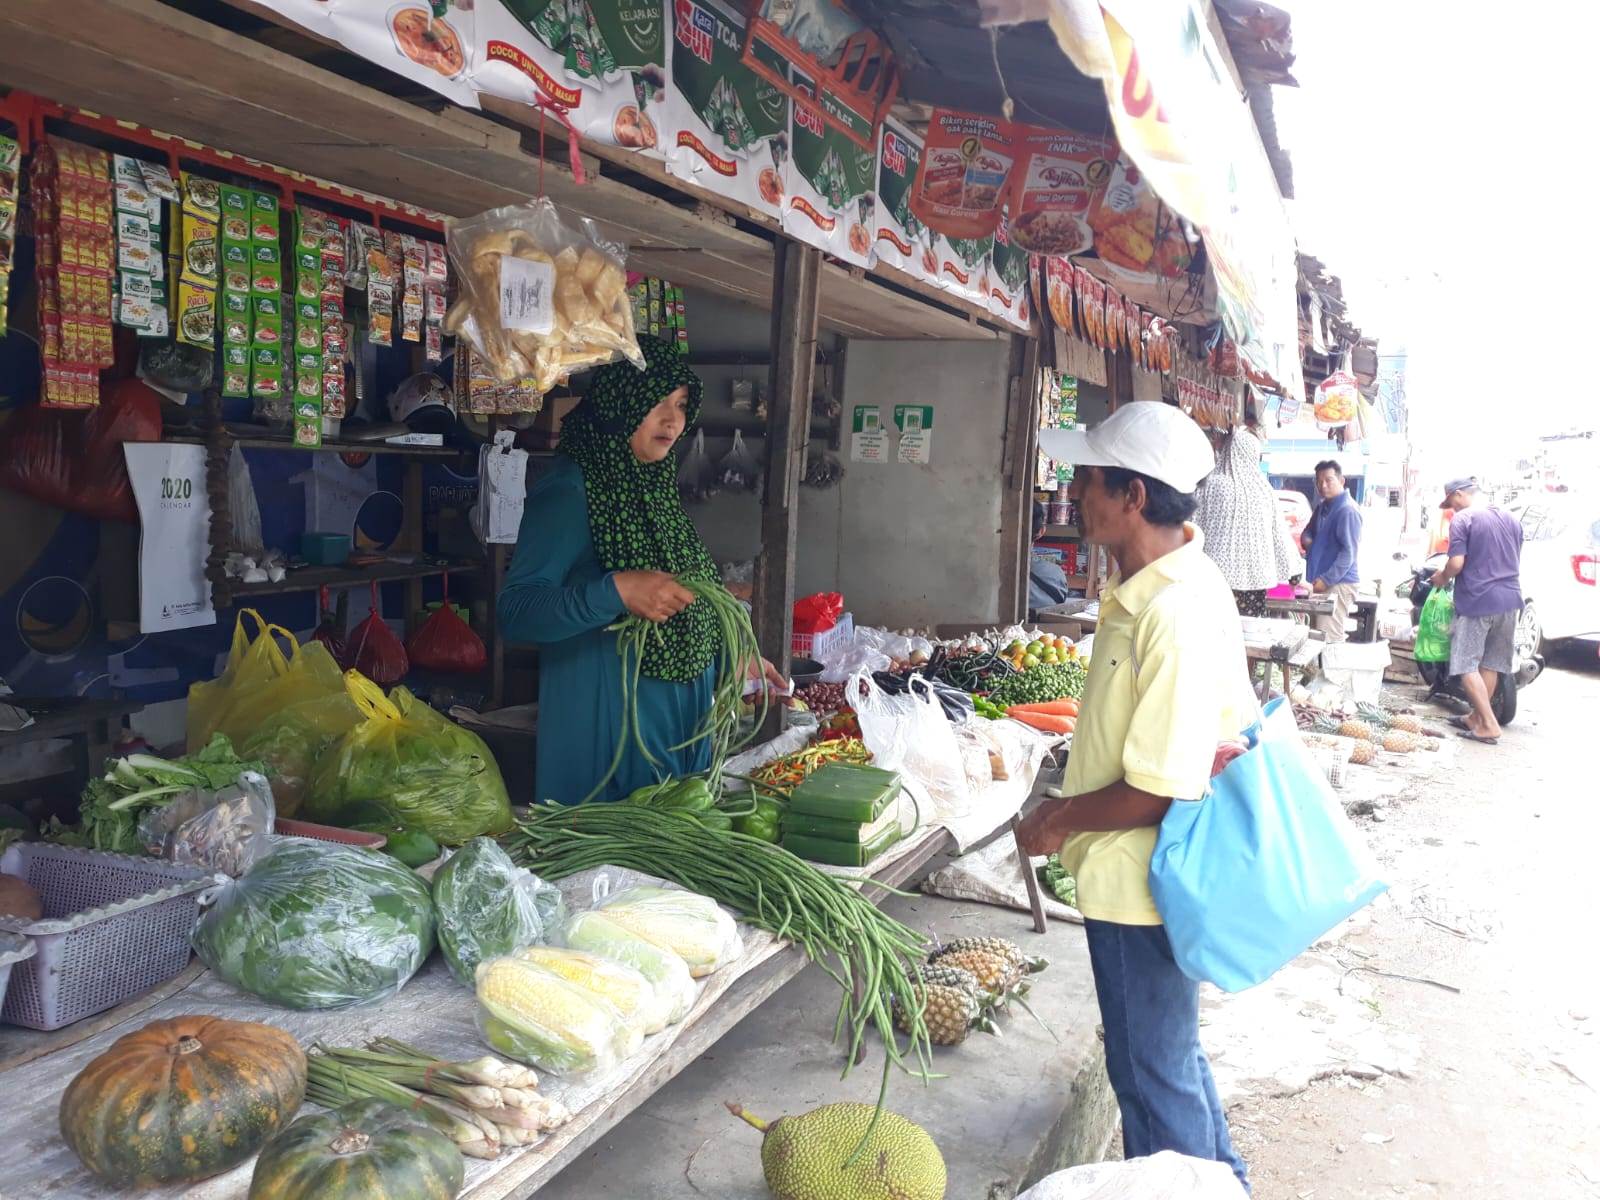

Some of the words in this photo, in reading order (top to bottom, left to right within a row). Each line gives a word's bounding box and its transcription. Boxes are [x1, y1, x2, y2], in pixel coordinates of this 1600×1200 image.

[490, 46, 519, 62] COCOK
[521, 57, 545, 84] UNTUK
[555, 88, 577, 103] MASAK
[940, 116, 962, 126] Bikin
[161, 477, 192, 499] 2020
